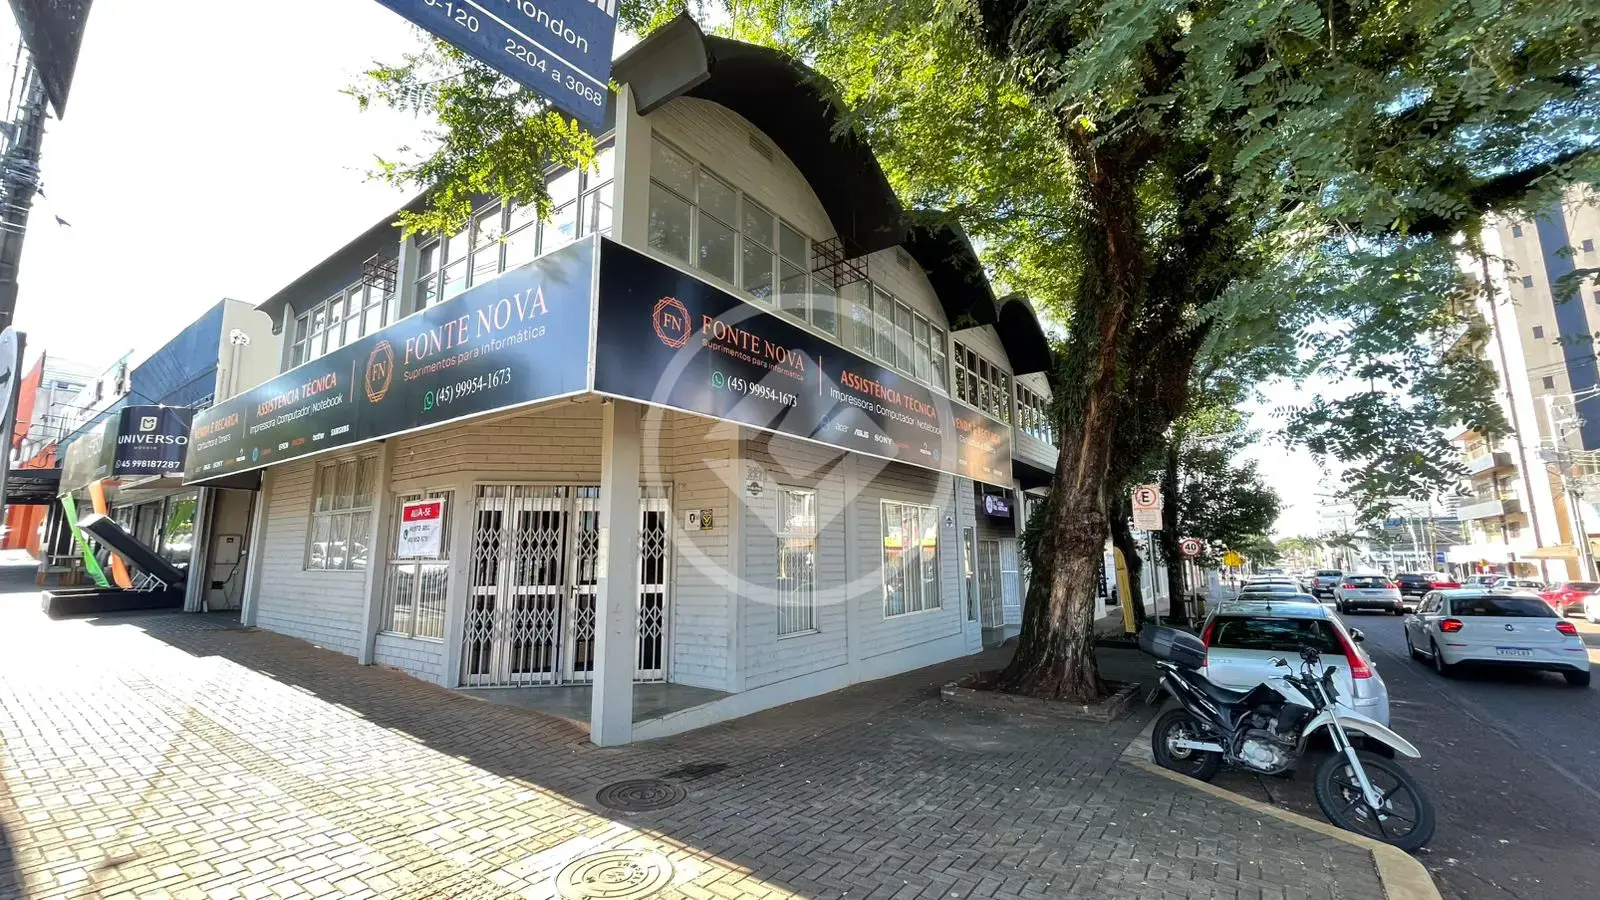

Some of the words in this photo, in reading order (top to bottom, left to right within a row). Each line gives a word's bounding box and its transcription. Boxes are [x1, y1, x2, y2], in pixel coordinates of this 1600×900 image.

[504, 38, 547, 73] 2204
[552, 70, 561, 84] a
[565, 77, 602, 107] 3068
[403, 314, 470, 366] FONTE
[475, 284, 549, 338] NOVA
[662, 312, 682, 332] FN
[701, 314, 761, 355] FONTE
[763, 339, 805, 372] NOVA
[701, 338, 752, 362] Suprimentos
[751, 356, 768, 369] para
[371, 360, 387, 383] FN
[403, 353, 456, 382] Suprimentos
[458, 347, 479, 366] para
[256, 387, 300, 418] ASSISTÊNCIA
[301, 371, 337, 399] TÉCNICA
[436, 384, 454, 407] (45)
[454, 367, 512, 399] 99954-1673
[727, 375, 747, 395] (45)
[749, 381, 797, 408] 99954-1673
[840, 370, 902, 407] ASSISTÊNCIA
[904, 393, 937, 419] TÉCNICA
[250, 419, 276, 435] Impressora
[276, 405, 311, 424] Computador
[312, 392, 344, 413] Notebook
[830, 387, 874, 413] Impressora
[876, 404, 915, 426] Computador
[118, 434, 188, 445] UNIVERSO
[835, 422, 849, 433] acer
[854, 428, 870, 439] ASUS
[874, 434, 893, 445] SONY
[121, 460, 130, 468] 45
[132, 460, 180, 469] 998187287
[1142, 492, 1150, 502] E
[1185, 543, 1196, 551] 40
